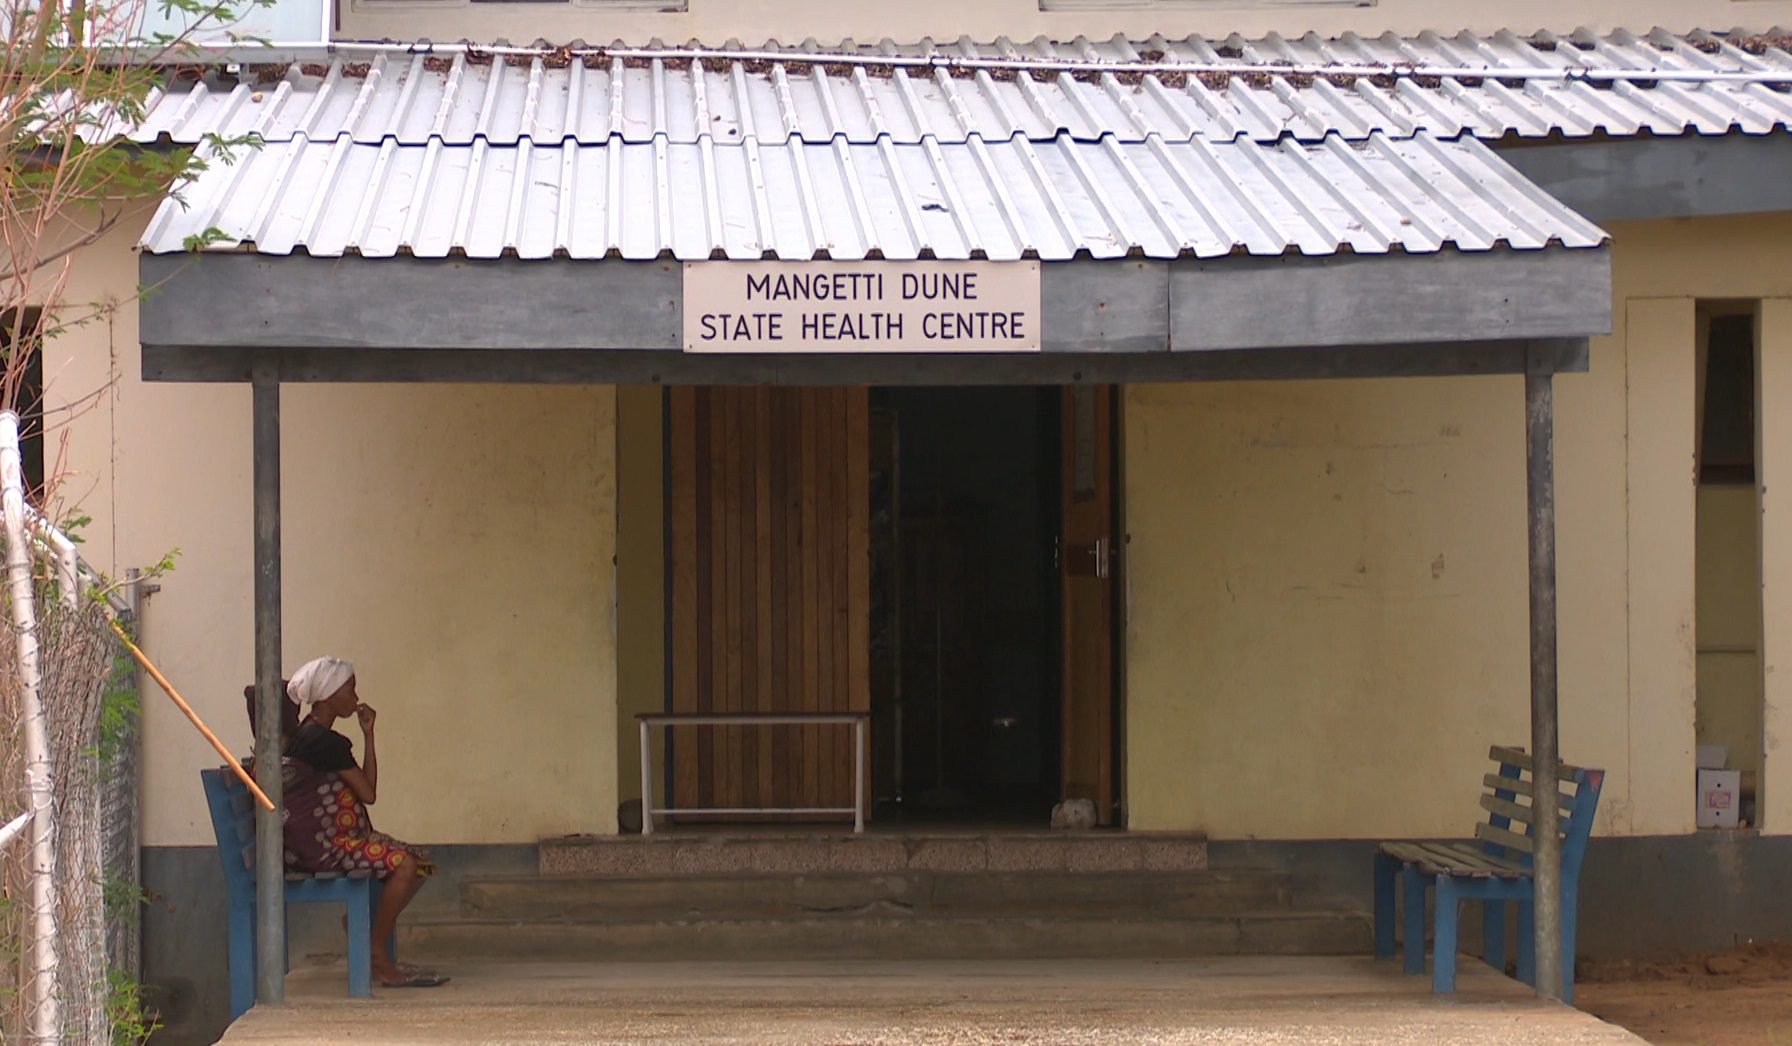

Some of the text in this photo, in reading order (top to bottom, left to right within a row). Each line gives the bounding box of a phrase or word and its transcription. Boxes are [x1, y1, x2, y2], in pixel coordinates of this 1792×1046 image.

[747, 273, 978, 300] MANGETTI DUNE
[701, 312, 1025, 341] STATE HEALTH CENTRE
